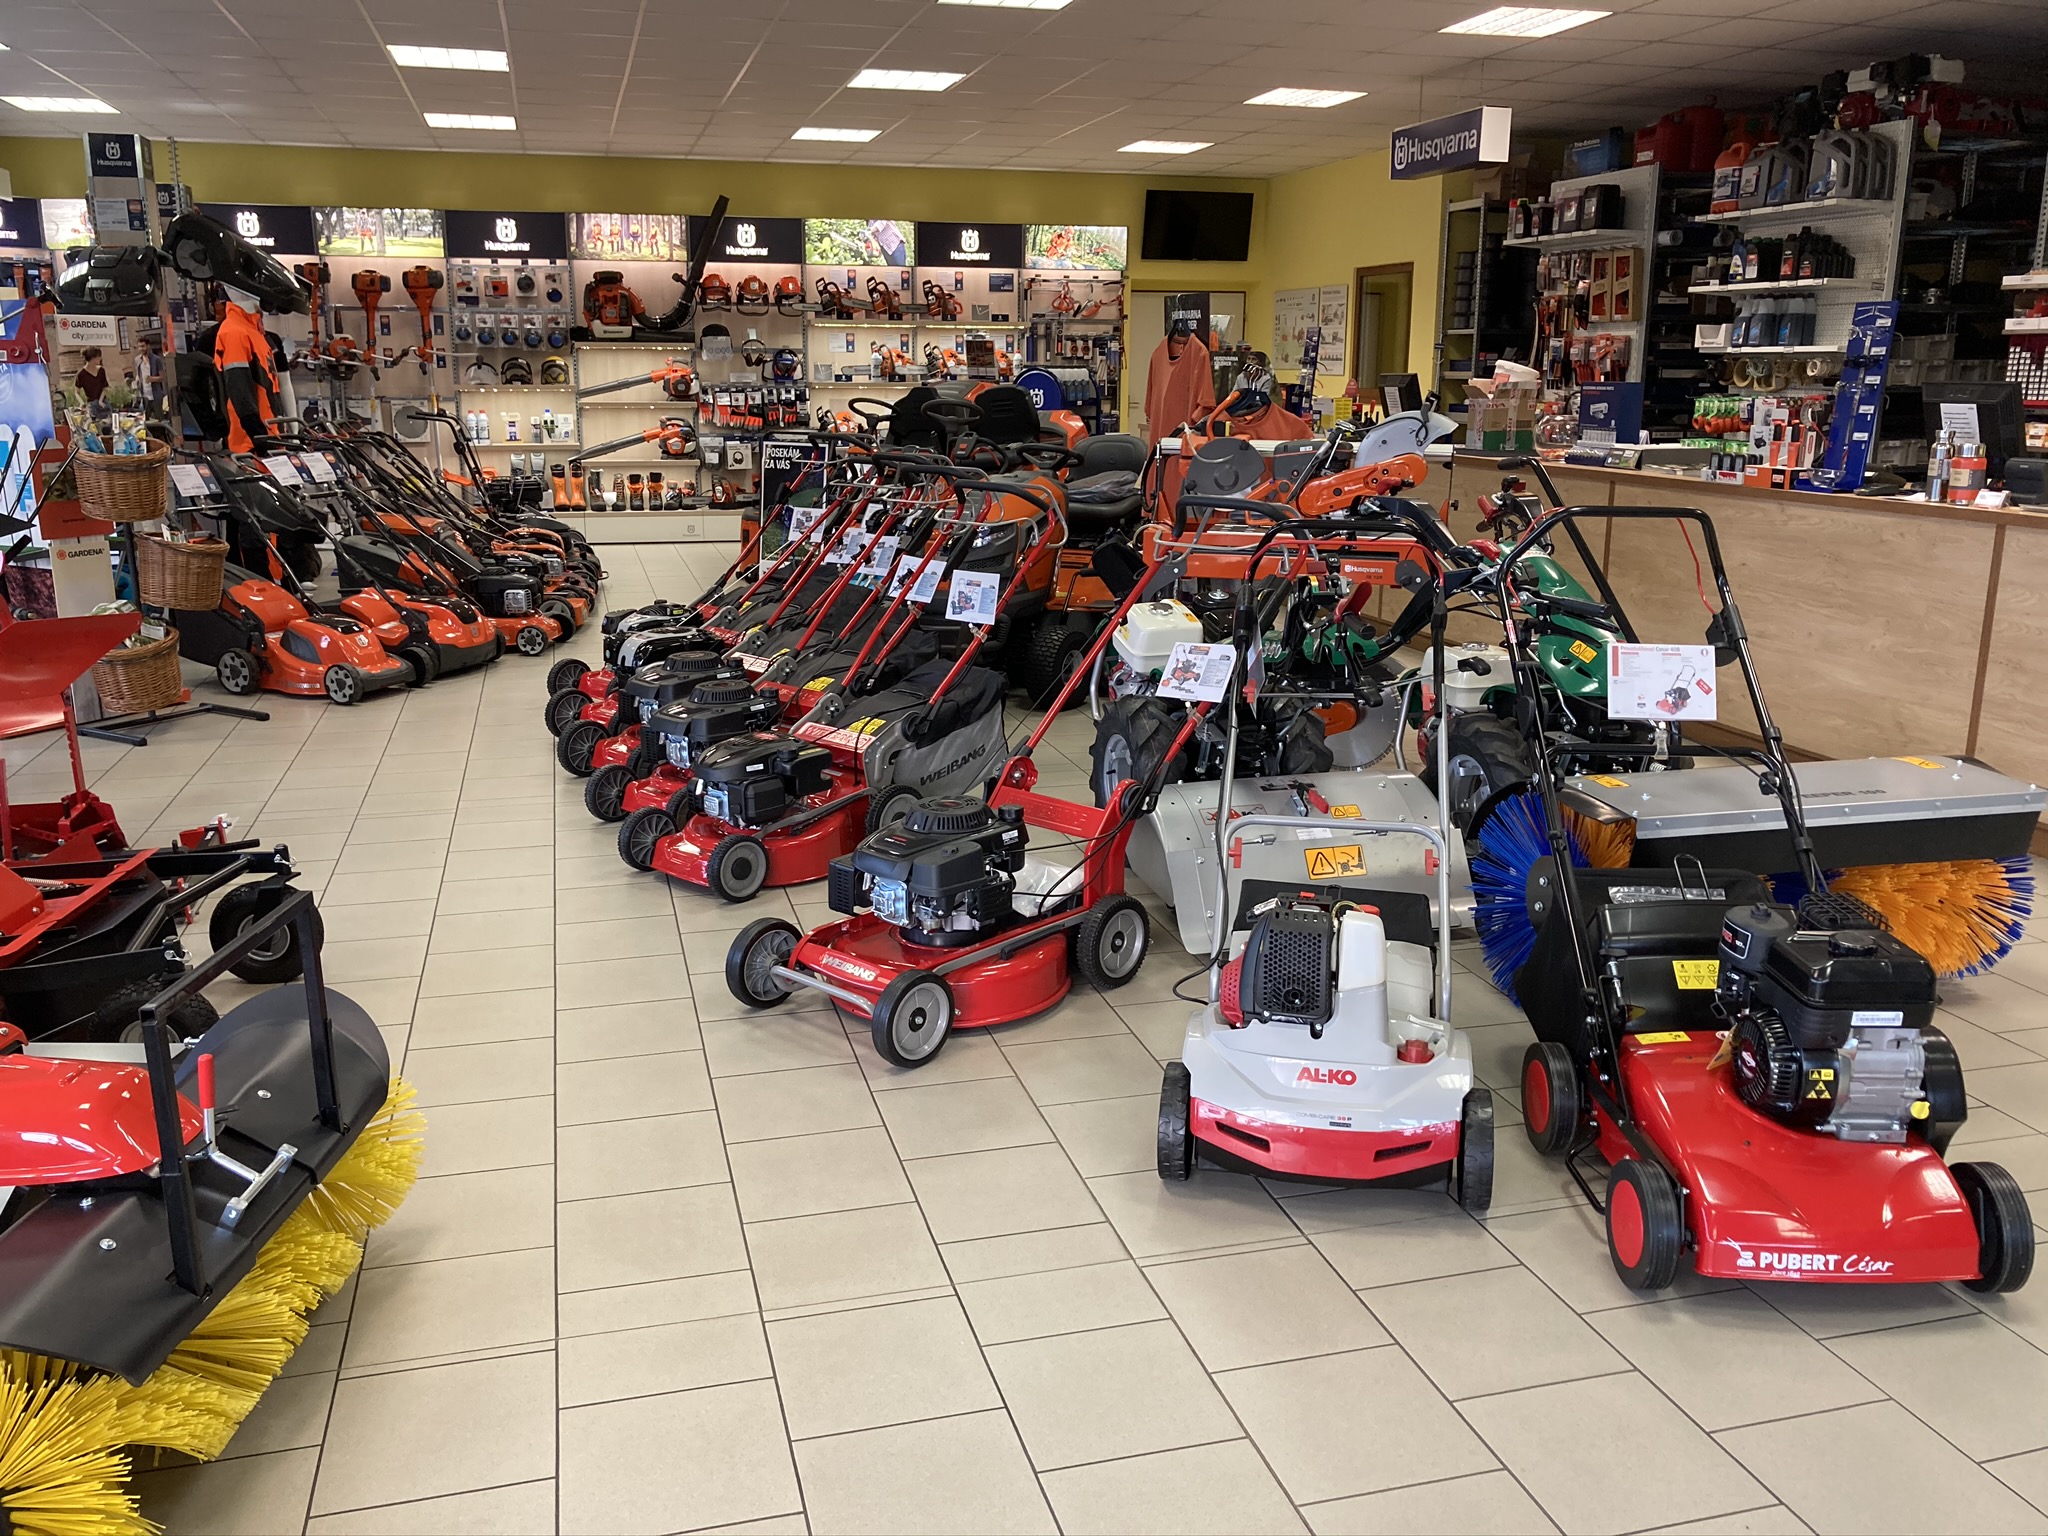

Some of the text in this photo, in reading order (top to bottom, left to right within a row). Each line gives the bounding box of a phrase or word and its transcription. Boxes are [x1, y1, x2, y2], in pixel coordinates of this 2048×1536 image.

[1407, 129, 1478, 163] Husqvarna
[97, 159, 132, 167] Husqvarna
[484, 240, 531, 251] Husqvarna
[726, 245, 768, 256] Husqvarna
[950, 250, 991, 261] Husqvarna
[71, 320, 107, 329] GARDENA
[767, 447, 800, 458] POSEKÁM
[766, 458, 791, 470] ZA VÁS
[68, 548, 103, 558] GARDENA
[1351, 565, 1384, 574] Husqvarna
[919, 744, 986, 787] WEIBANG
[822, 954, 876, 982] WEIBANG
[1296, 1066, 1358, 1086] AL-KO
[1296, 1111, 1336, 1120] COMBI-CARE
[1759, 1252, 1895, 1273] PUBERT César
